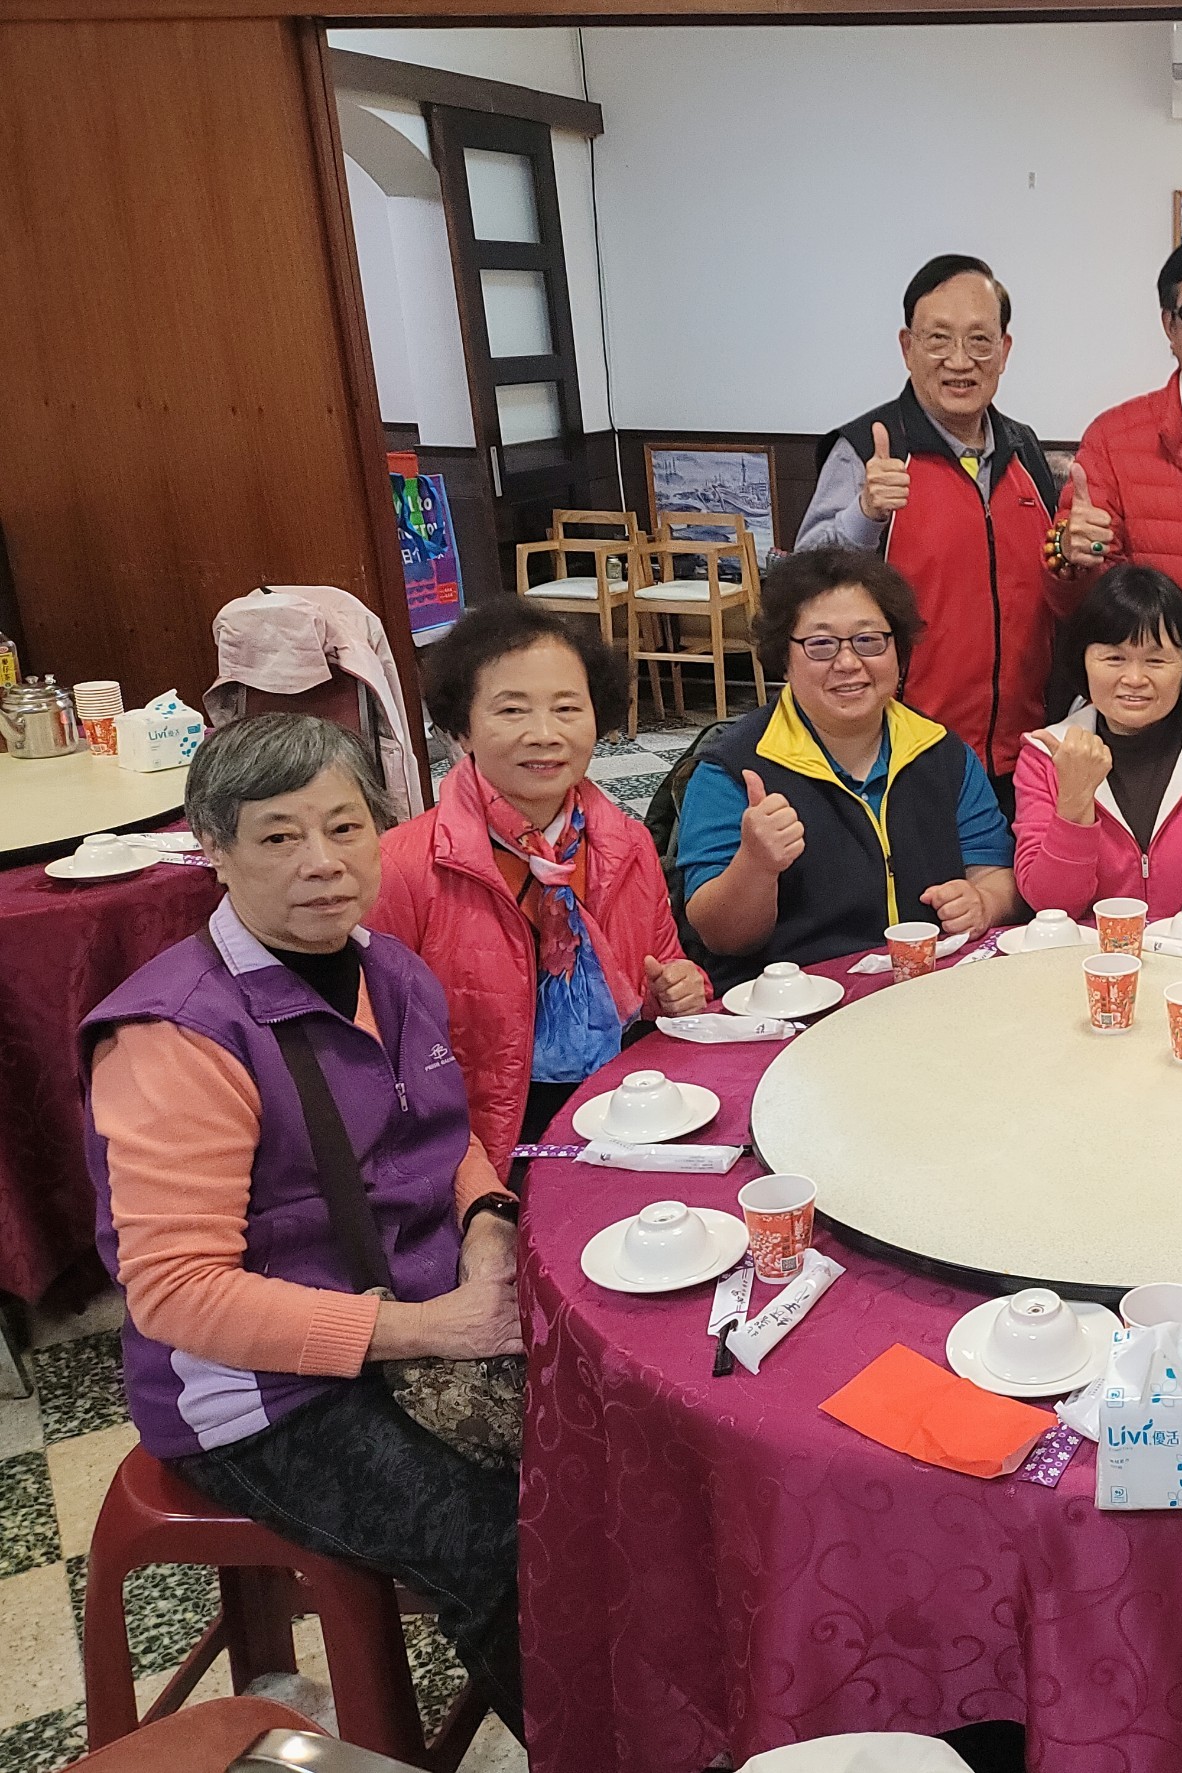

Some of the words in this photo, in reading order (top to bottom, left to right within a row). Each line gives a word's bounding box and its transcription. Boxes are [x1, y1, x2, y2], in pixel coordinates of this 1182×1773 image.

[148, 726, 168, 741] Livi
[1107, 1418, 1153, 1447] Livi
[1152, 1430, 1180, 1445] 優活
